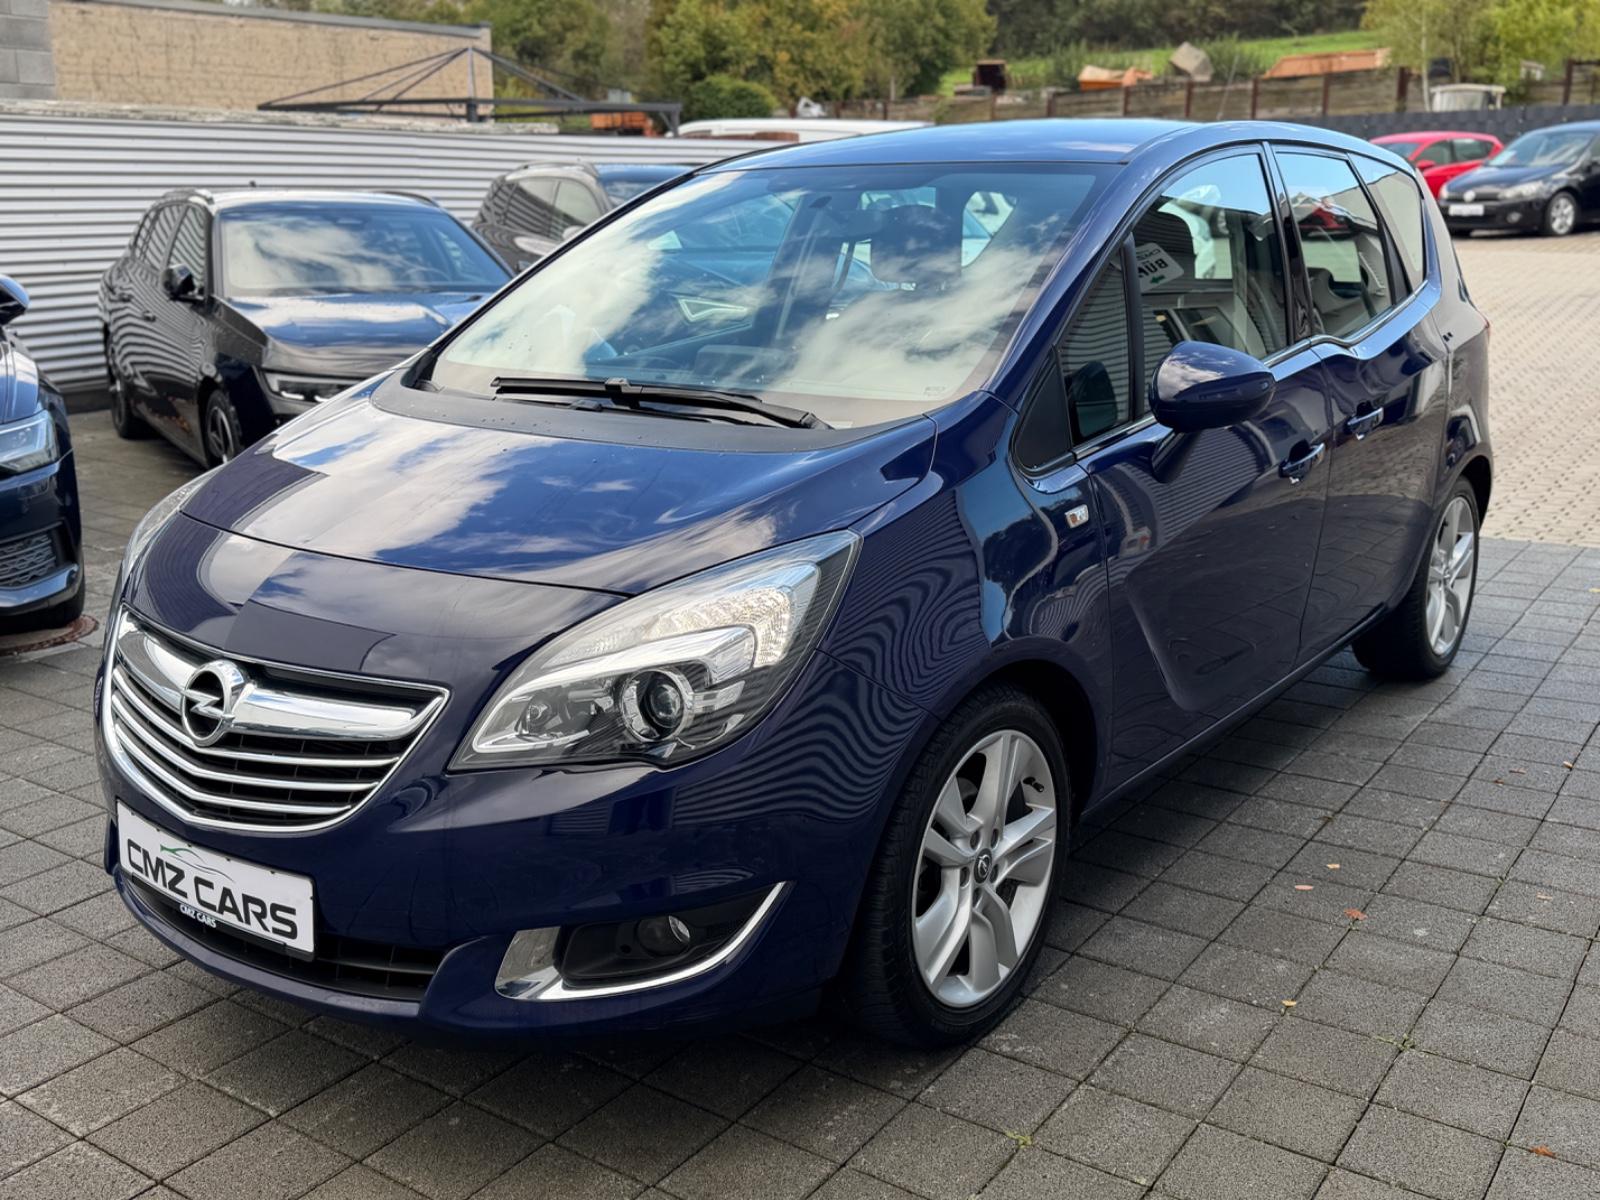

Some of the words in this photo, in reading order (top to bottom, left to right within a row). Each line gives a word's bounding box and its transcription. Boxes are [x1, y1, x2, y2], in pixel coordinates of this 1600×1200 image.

[127, 838, 188, 899] CMZ
[194, 875, 298, 940] CARS
[179, 903, 196, 918] CMZ
[197, 913, 217, 928] CARS
